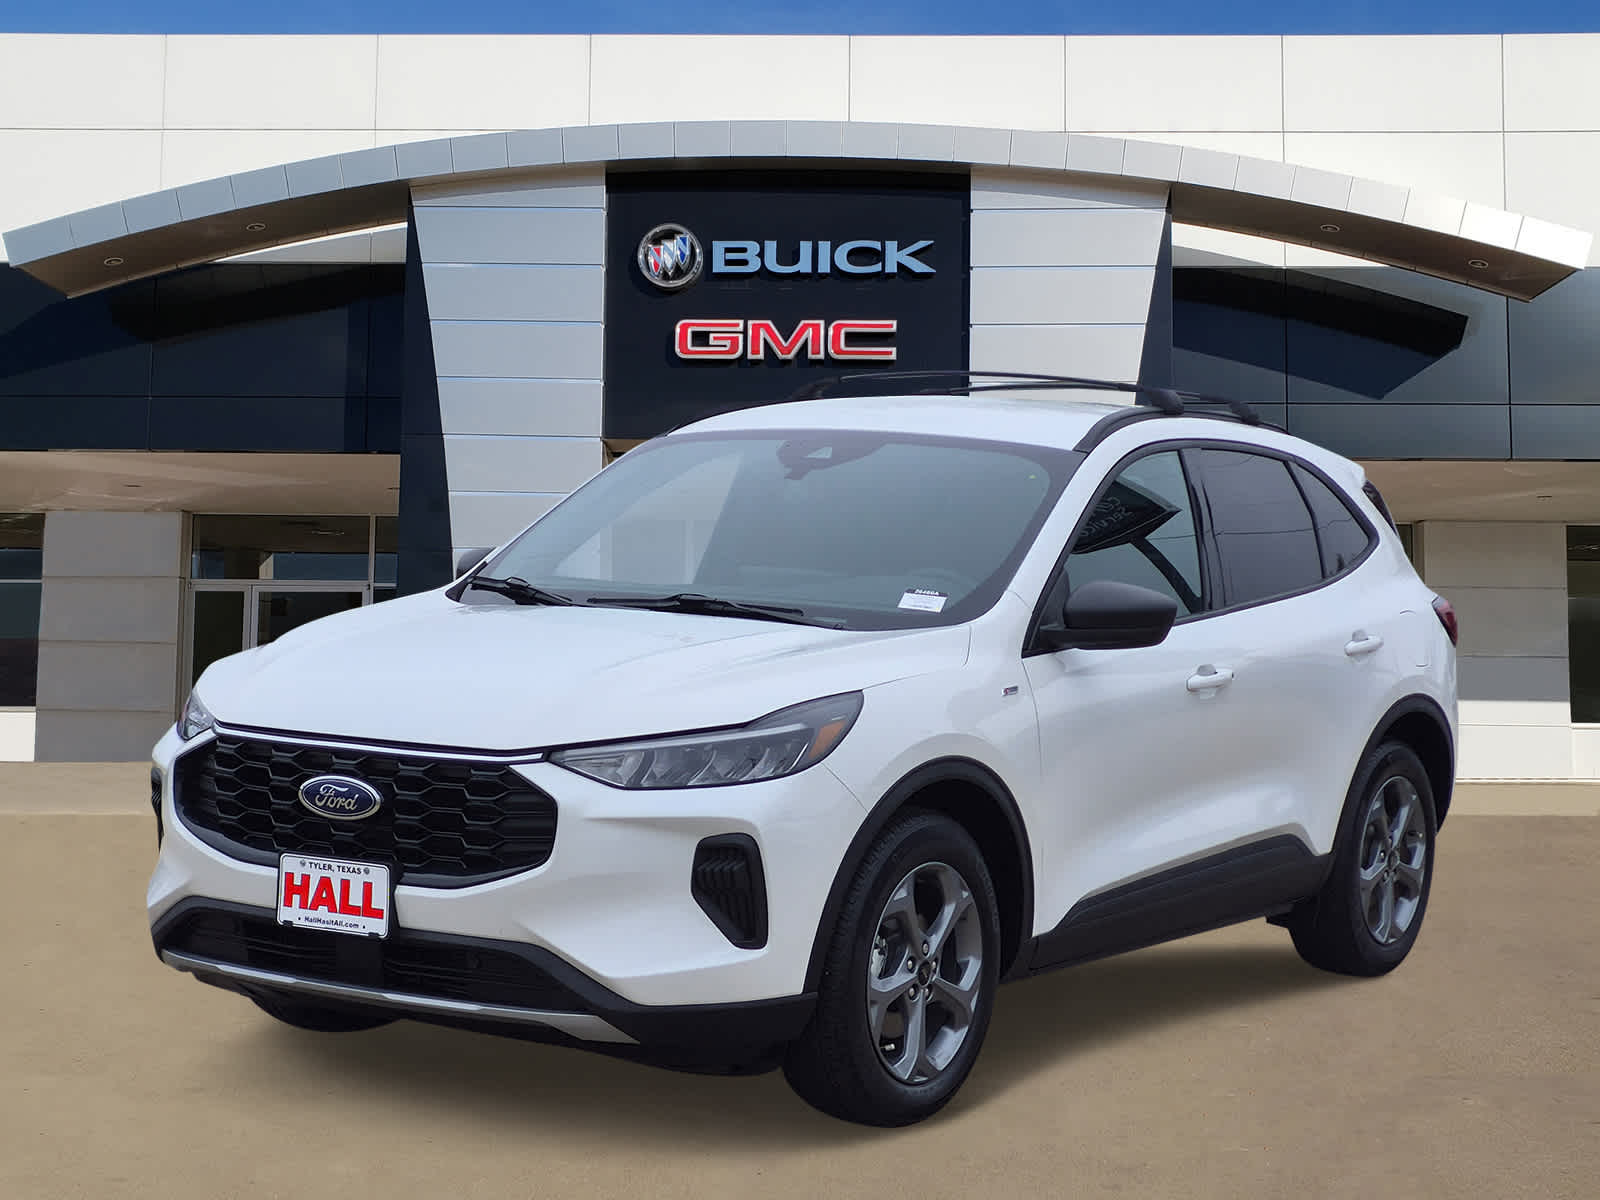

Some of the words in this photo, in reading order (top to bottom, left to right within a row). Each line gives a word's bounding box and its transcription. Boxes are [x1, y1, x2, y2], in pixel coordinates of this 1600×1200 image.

[712, 240, 936, 274] BUICK
[675, 319, 897, 360] GMC
[315, 784, 359, 810] Ford
[309, 862, 334, 872] TYLER,
[337, 865, 361, 874] TEXAS
[283, 872, 384, 919] HALL
